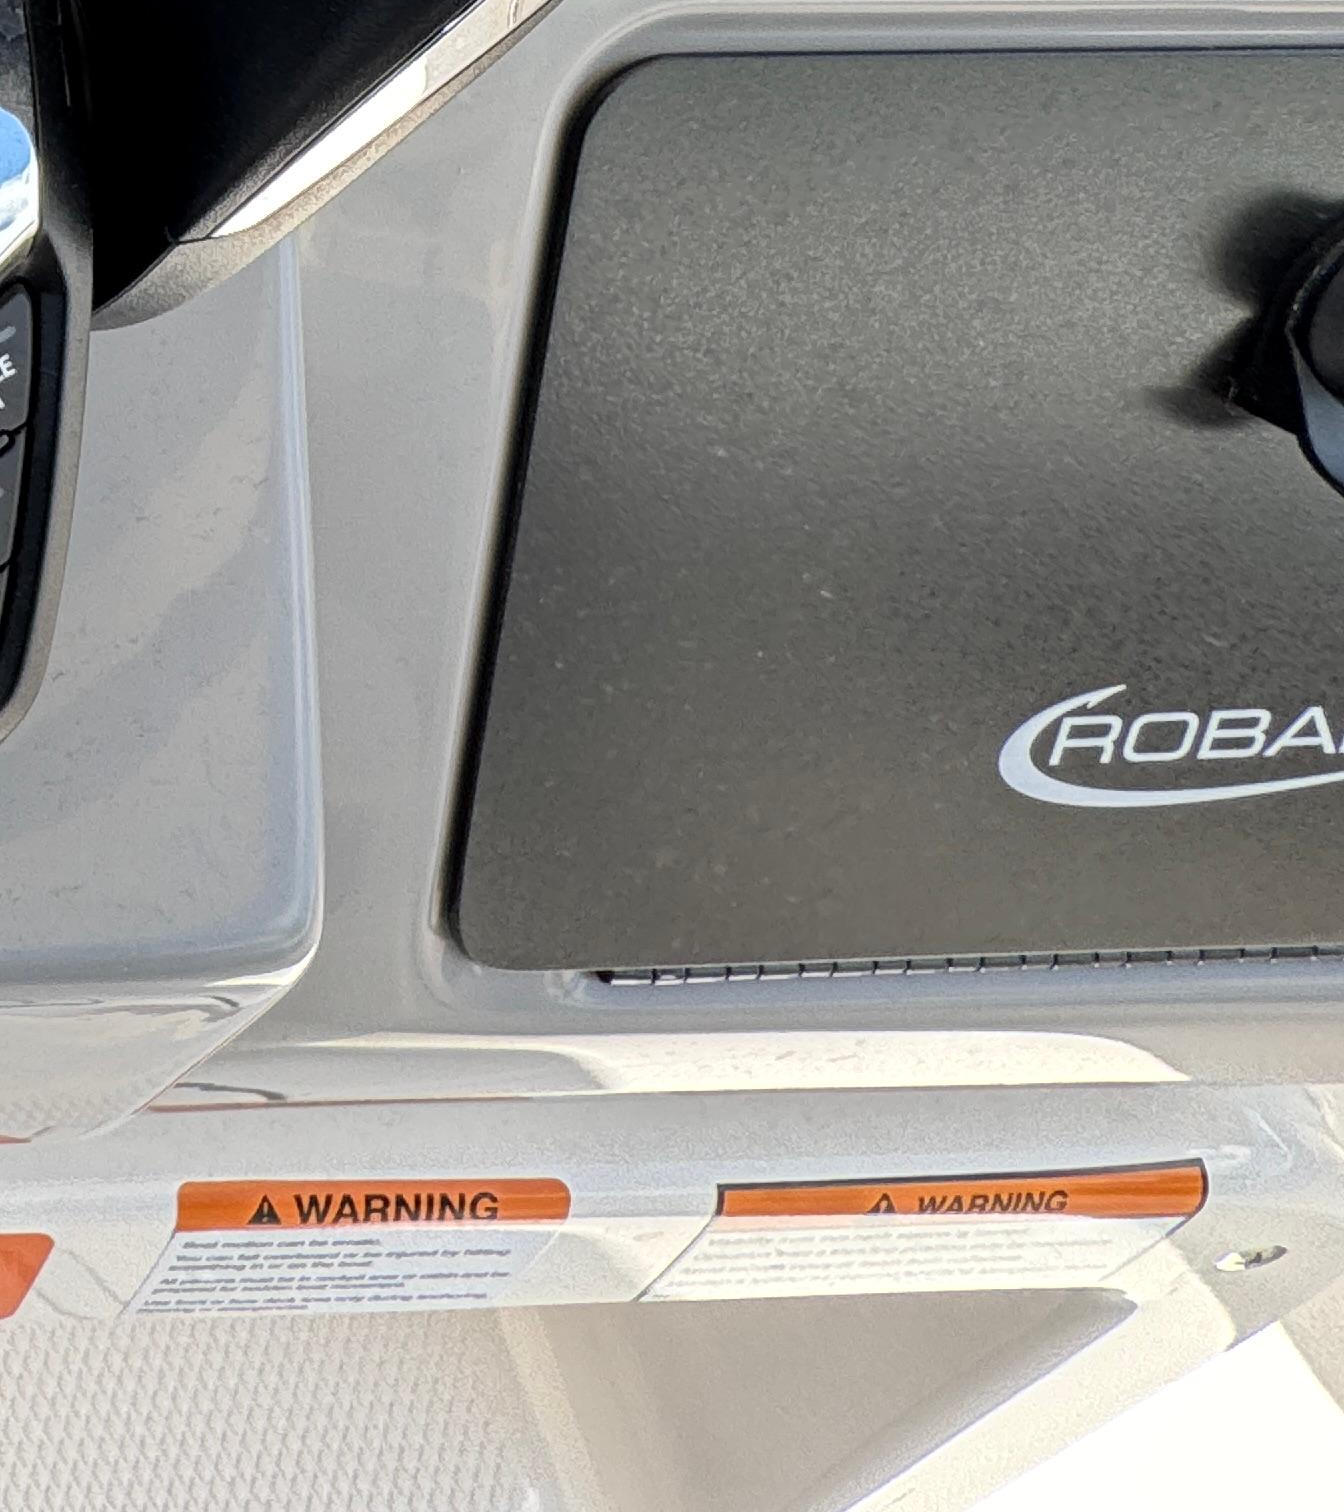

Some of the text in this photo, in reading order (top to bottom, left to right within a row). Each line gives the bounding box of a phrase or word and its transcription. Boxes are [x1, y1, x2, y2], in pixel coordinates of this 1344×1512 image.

[1048, 704, 1344, 767] ROBA
[294, 1192, 499, 1224] WARNING
[916, 1189, 1069, 1215] WARNING
